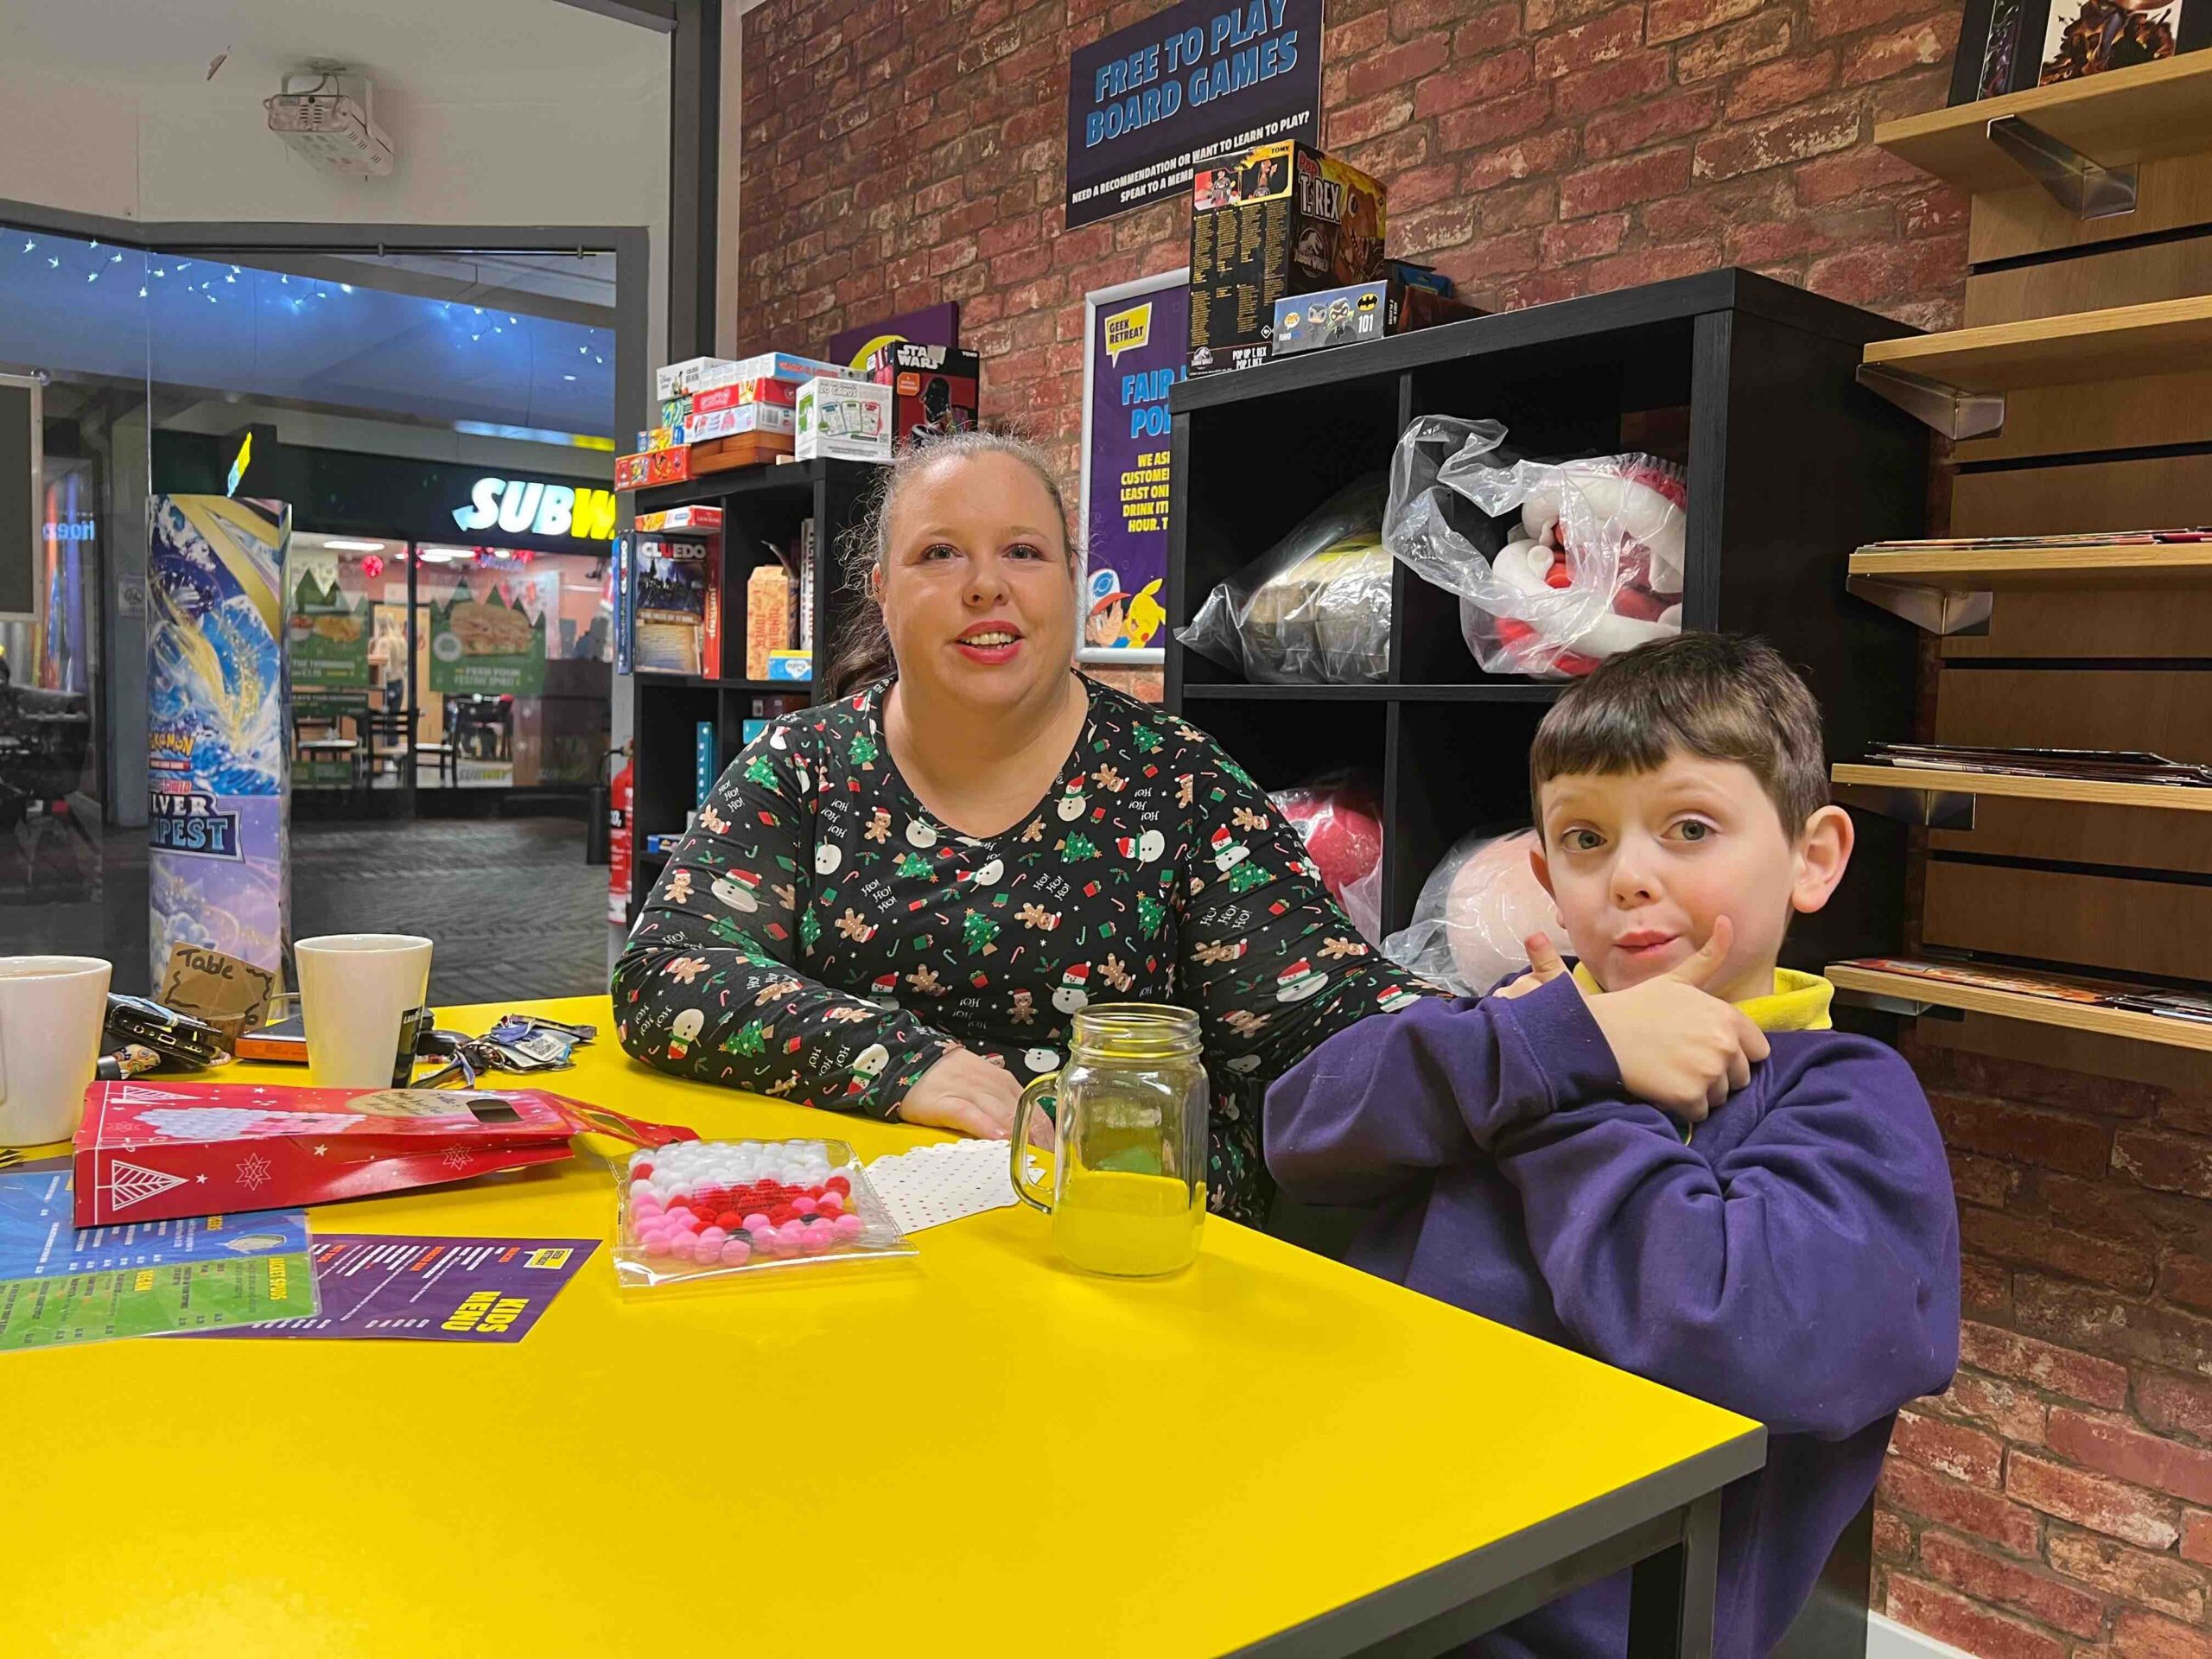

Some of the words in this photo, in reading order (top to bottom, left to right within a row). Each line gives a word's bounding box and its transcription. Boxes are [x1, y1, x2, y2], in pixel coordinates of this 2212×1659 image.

[1095, 44, 1160, 103] FREE
[1165, 27, 1204, 73] TO
[1211, 0, 1286, 55] PLAY
[1086, 80, 1182, 148] BOARD
[1188, 30, 1297, 107] GAMES
[1072, 188, 1093, 205] NEED
[1093, 185, 1100, 197] A
[1100, 157, 1178, 193] RECOMMENDATION
[1178, 152, 1191, 168] OR
[1192, 143, 1219, 163] WANT
[1219, 138, 1233, 151] TO
[1234, 127, 1265, 149] LEARN
[1265, 122, 1278, 137] TO
[1280, 111, 1310, 133] PLAY?
[1271, 145, 1289, 155] TOMY
[1120, 187, 1147, 204] SPEAK
[1147, 181, 1160, 195] TO
[1160, 180, 1166, 190] A
[1314, 179, 1340, 222] REX
[1109, 318, 1129, 334] GEEK
[1357, 314, 1374, 334] 101
[1109, 326, 1144, 345] RETREAT
[897, 344, 931, 358] STA
[897, 354, 938, 370] WARS
[1122, 369, 1175, 406] FAIR
[1138, 453, 1153, 468] WE
[1121, 486, 1149, 502] LEAST
[451, 477, 616, 541] SUBW
[1122, 501, 1154, 517] DRINK
[1128, 518, 1160, 532] HOUR.
[642, 541, 707, 559] CLUEDO
[176, 949, 234, 980] Table
[269, 1257, 286, 1278] JACKET
[134, 1269, 154, 1292] VEGAN
[269, 1278, 286, 1300] SPUDS
[441, 1291, 502, 1332] MENU
[476, 1298, 529, 1332] KIDS
